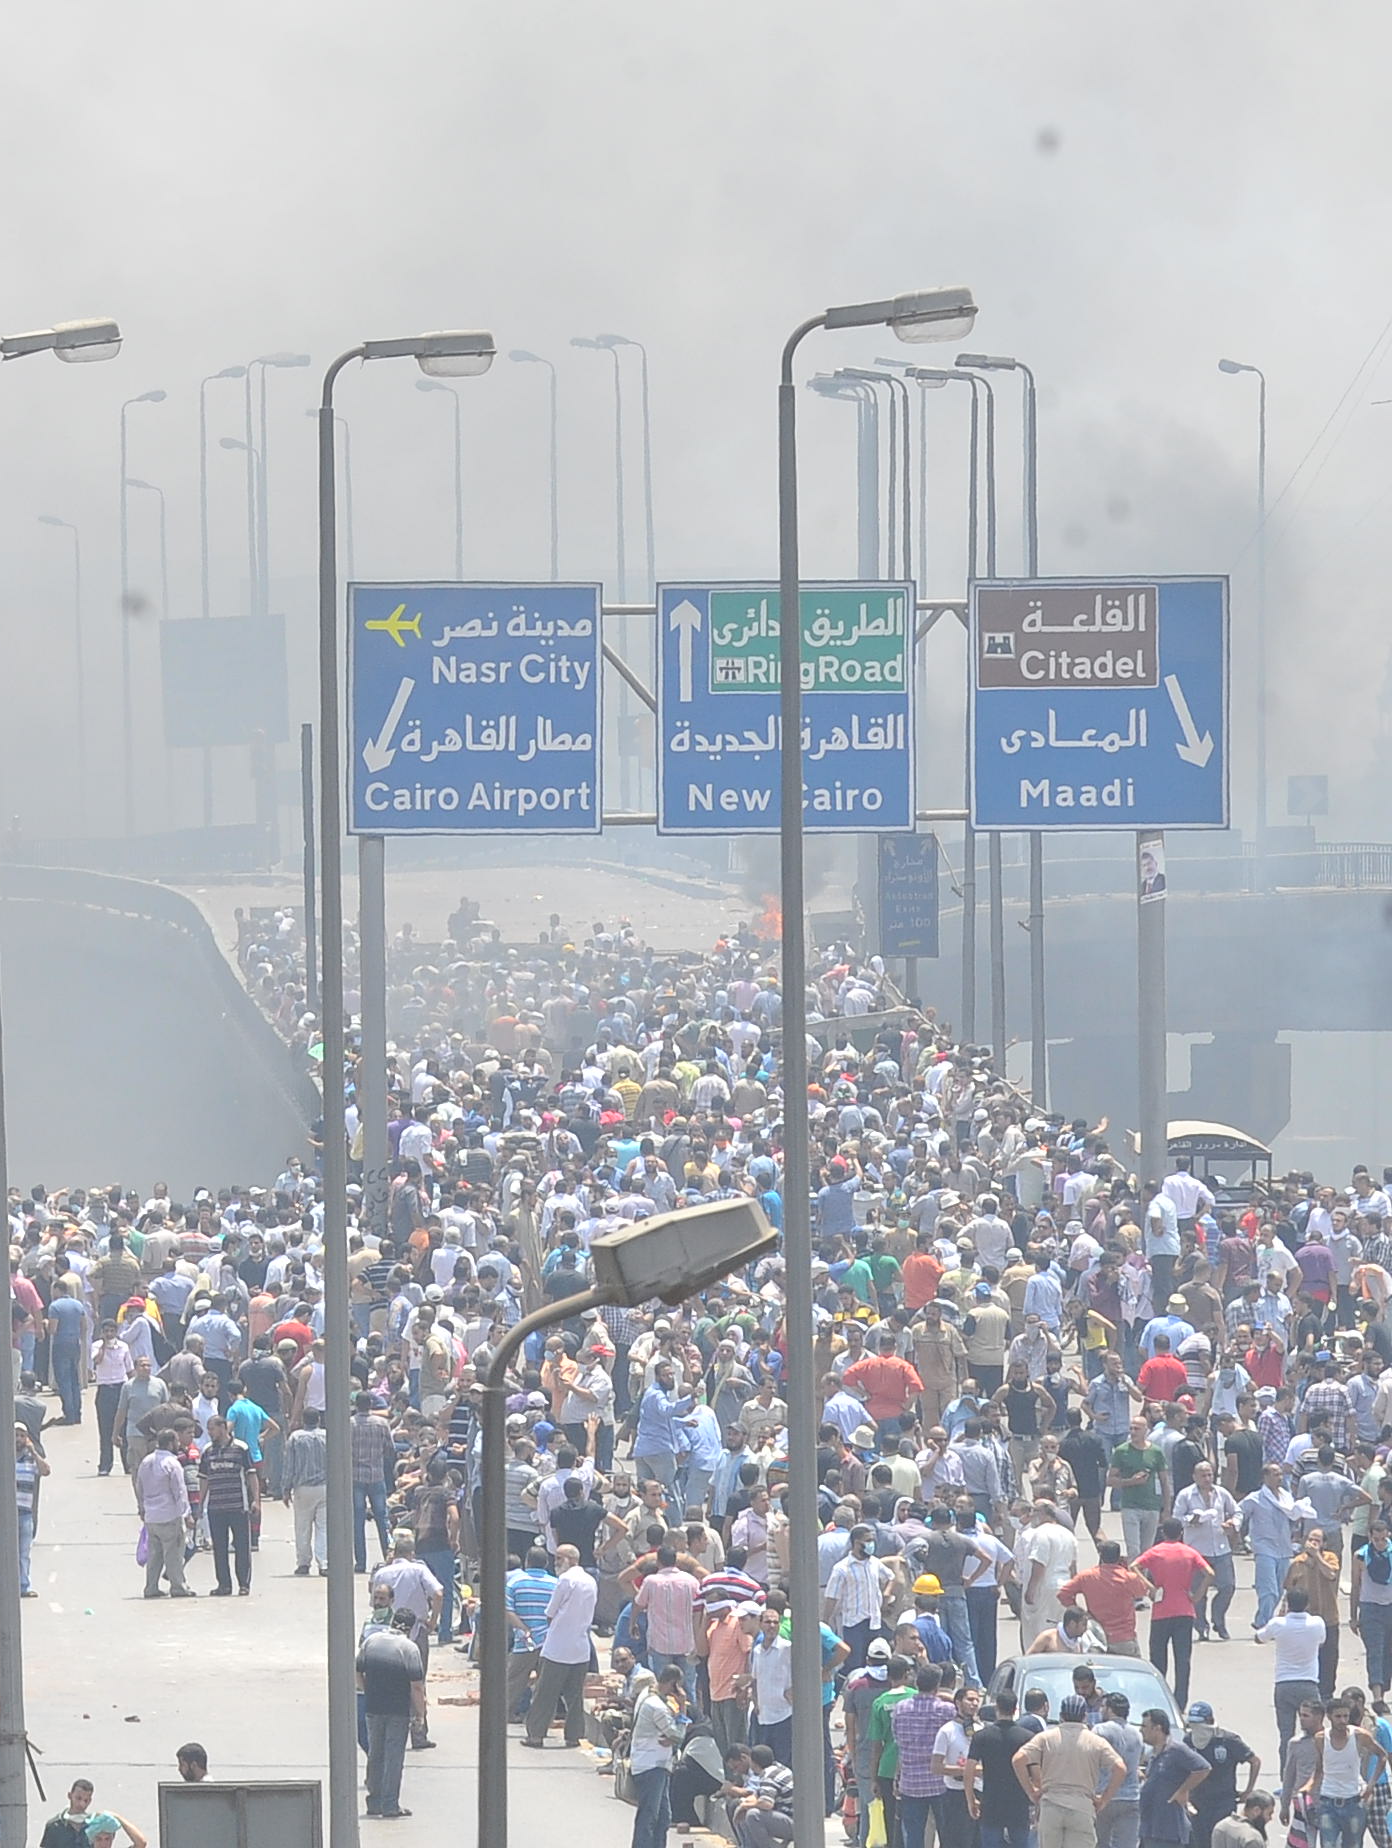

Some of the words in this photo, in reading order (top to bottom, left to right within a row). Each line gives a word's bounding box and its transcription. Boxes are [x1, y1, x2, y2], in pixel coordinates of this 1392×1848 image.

[432, 612, 499, 648] نصر
[506, 605, 593, 646] مدينة
[713, 598, 781, 648] دائرى
[804, 597, 903, 647] الطريق
[1022, 594, 1146, 632] القلعة
[432, 655, 512, 684] Nasr
[519, 653, 591, 690] City
[1019, 649, 1146, 680] Citadel
[401, 714, 516, 762] القاهرة
[517, 714, 593, 761] مطار
[365, 782, 459, 811] Cairo
[467, 781, 591, 816] Airport
[688, 782, 772, 811] New
[1019, 778, 1136, 808] Maadi
